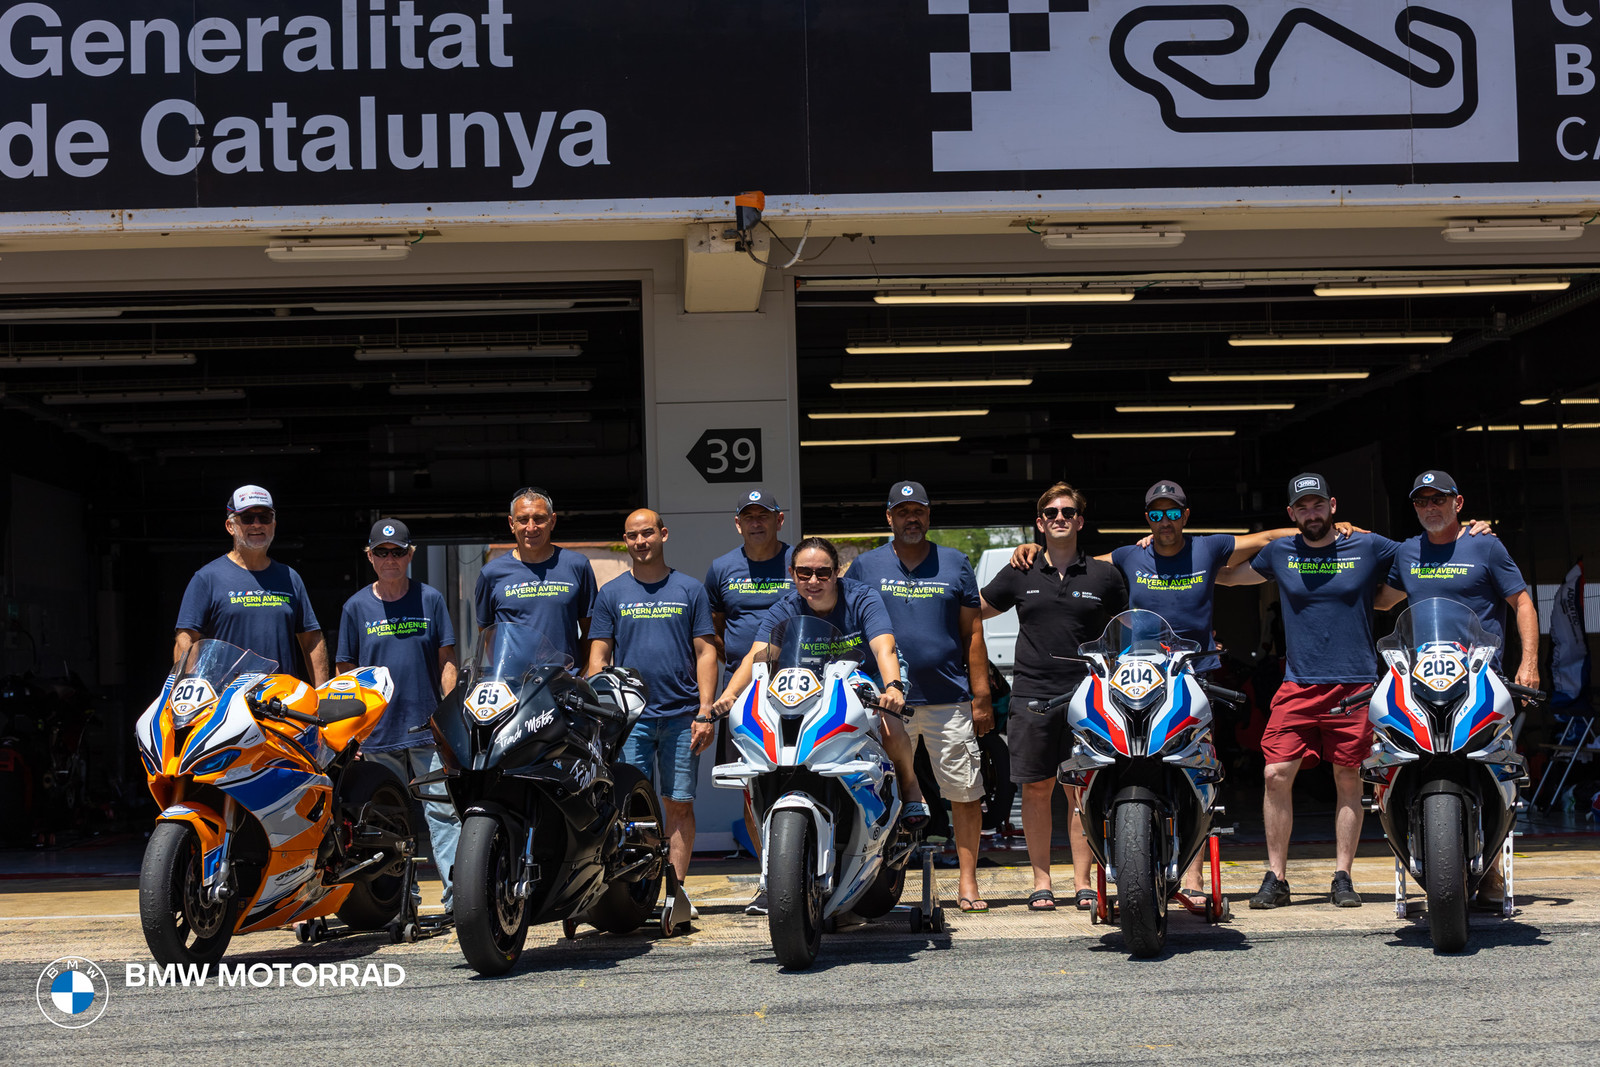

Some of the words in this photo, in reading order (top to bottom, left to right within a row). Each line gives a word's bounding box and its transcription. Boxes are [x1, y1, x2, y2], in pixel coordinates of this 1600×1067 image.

[0, 0, 515, 79] Generalitat
[0, 103, 110, 178] de
[140, 96, 611, 188] Catalunya
[706, 437, 756, 474] 39
[1288, 561, 1319, 570] BAYERN
[1320, 561, 1355, 569] AVENUE
[1436, 567, 1468, 575] AVENUE
[729, 582, 759, 590] BAYERN
[759, 582, 790, 590] AVENUE
[1136, 576, 1169, 586] BAYERN
[1170, 575, 1203, 586] AVENUE
[505, 586, 537, 597] BAYERN
[538, 585, 570, 593] AVENUE
[913, 586, 945, 595] AVENUE
[262, 595, 290, 604] AVENUE
[621, 607, 652, 617] BAYERN
[652, 606, 683, 615] AVENUE
[367, 623, 397, 635] BAYERN
[398, 621, 428, 630] AVENUE
[831, 636, 863, 649] AVENUE
[1423, 660, 1456, 678] 202
[778, 675, 810, 692] 203
[1121, 668, 1153, 686] 204
[174, 684, 205, 702] 201
[477, 688, 499, 705] 65
[787, 694, 795, 702] 12
